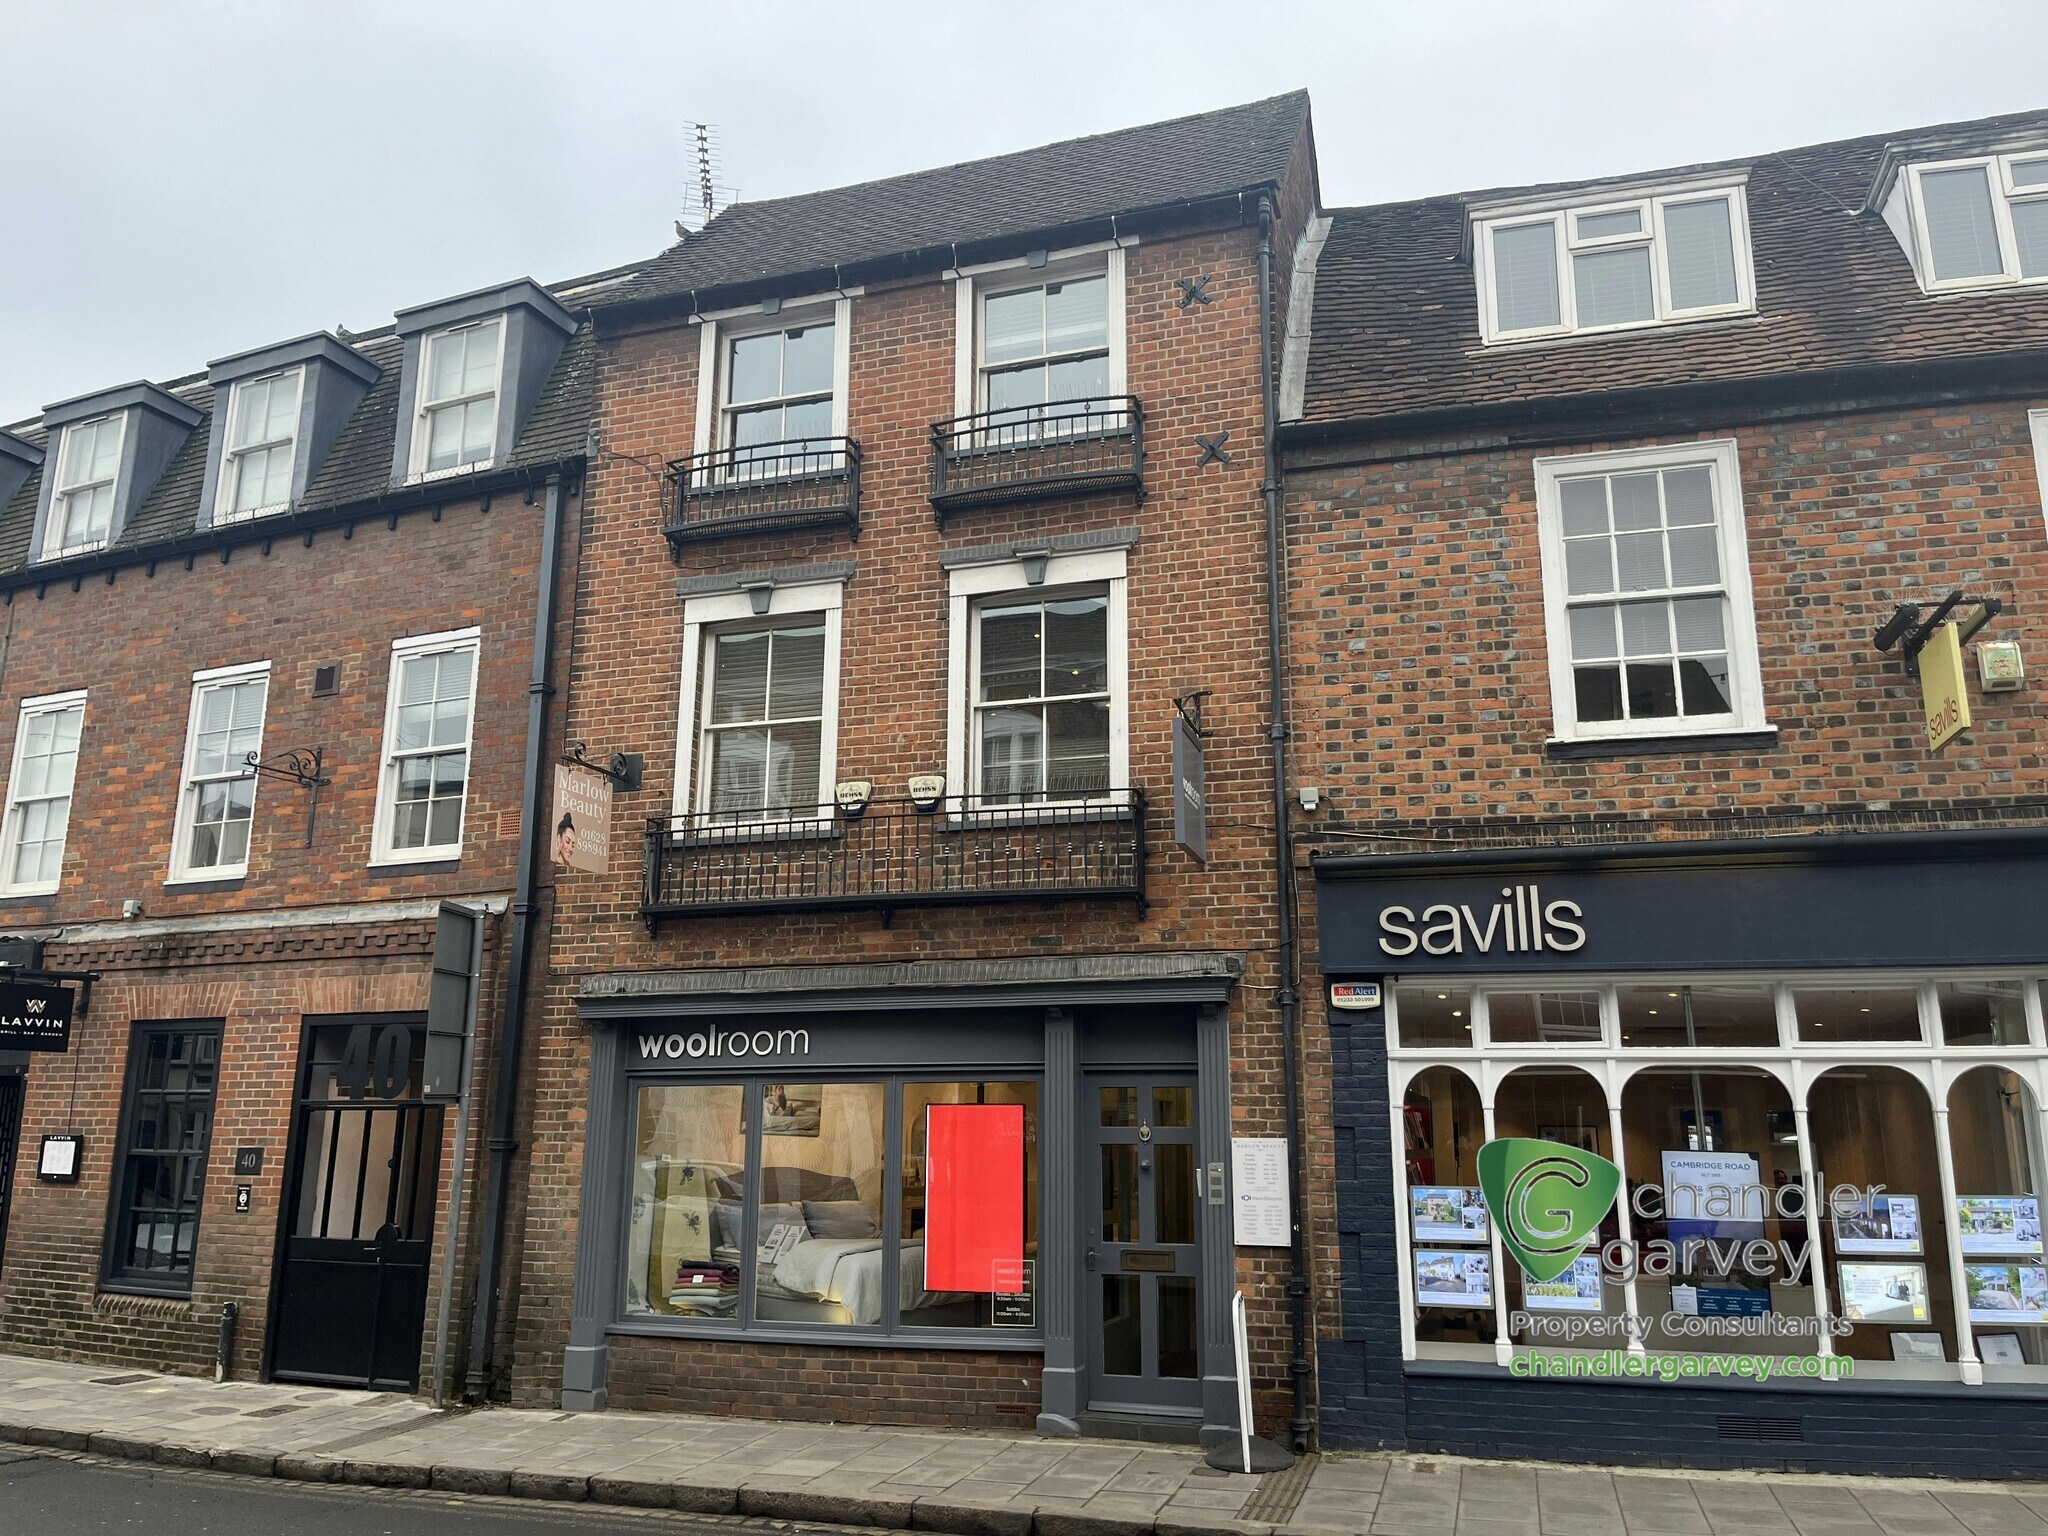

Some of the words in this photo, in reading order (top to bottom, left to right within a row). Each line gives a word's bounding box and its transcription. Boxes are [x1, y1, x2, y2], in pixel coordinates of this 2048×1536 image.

[1929, 696, 1958, 741] savills
[559, 771, 609, 803] Marlow
[560, 790, 606, 824] Beauty
[581, 828, 606, 845] 01628
[1378, 884, 1586, 956] savills
[1, 1016, 63, 1028] LAVVIN
[638, 1024, 810, 1059] woolroom
[336, 1023, 412, 1100] 40
[241, 1153, 256, 1168] 40
[1670, 1161, 1722, 1169] CAMBRIDGE
[1725, 1163, 1751, 1171] ROAD
